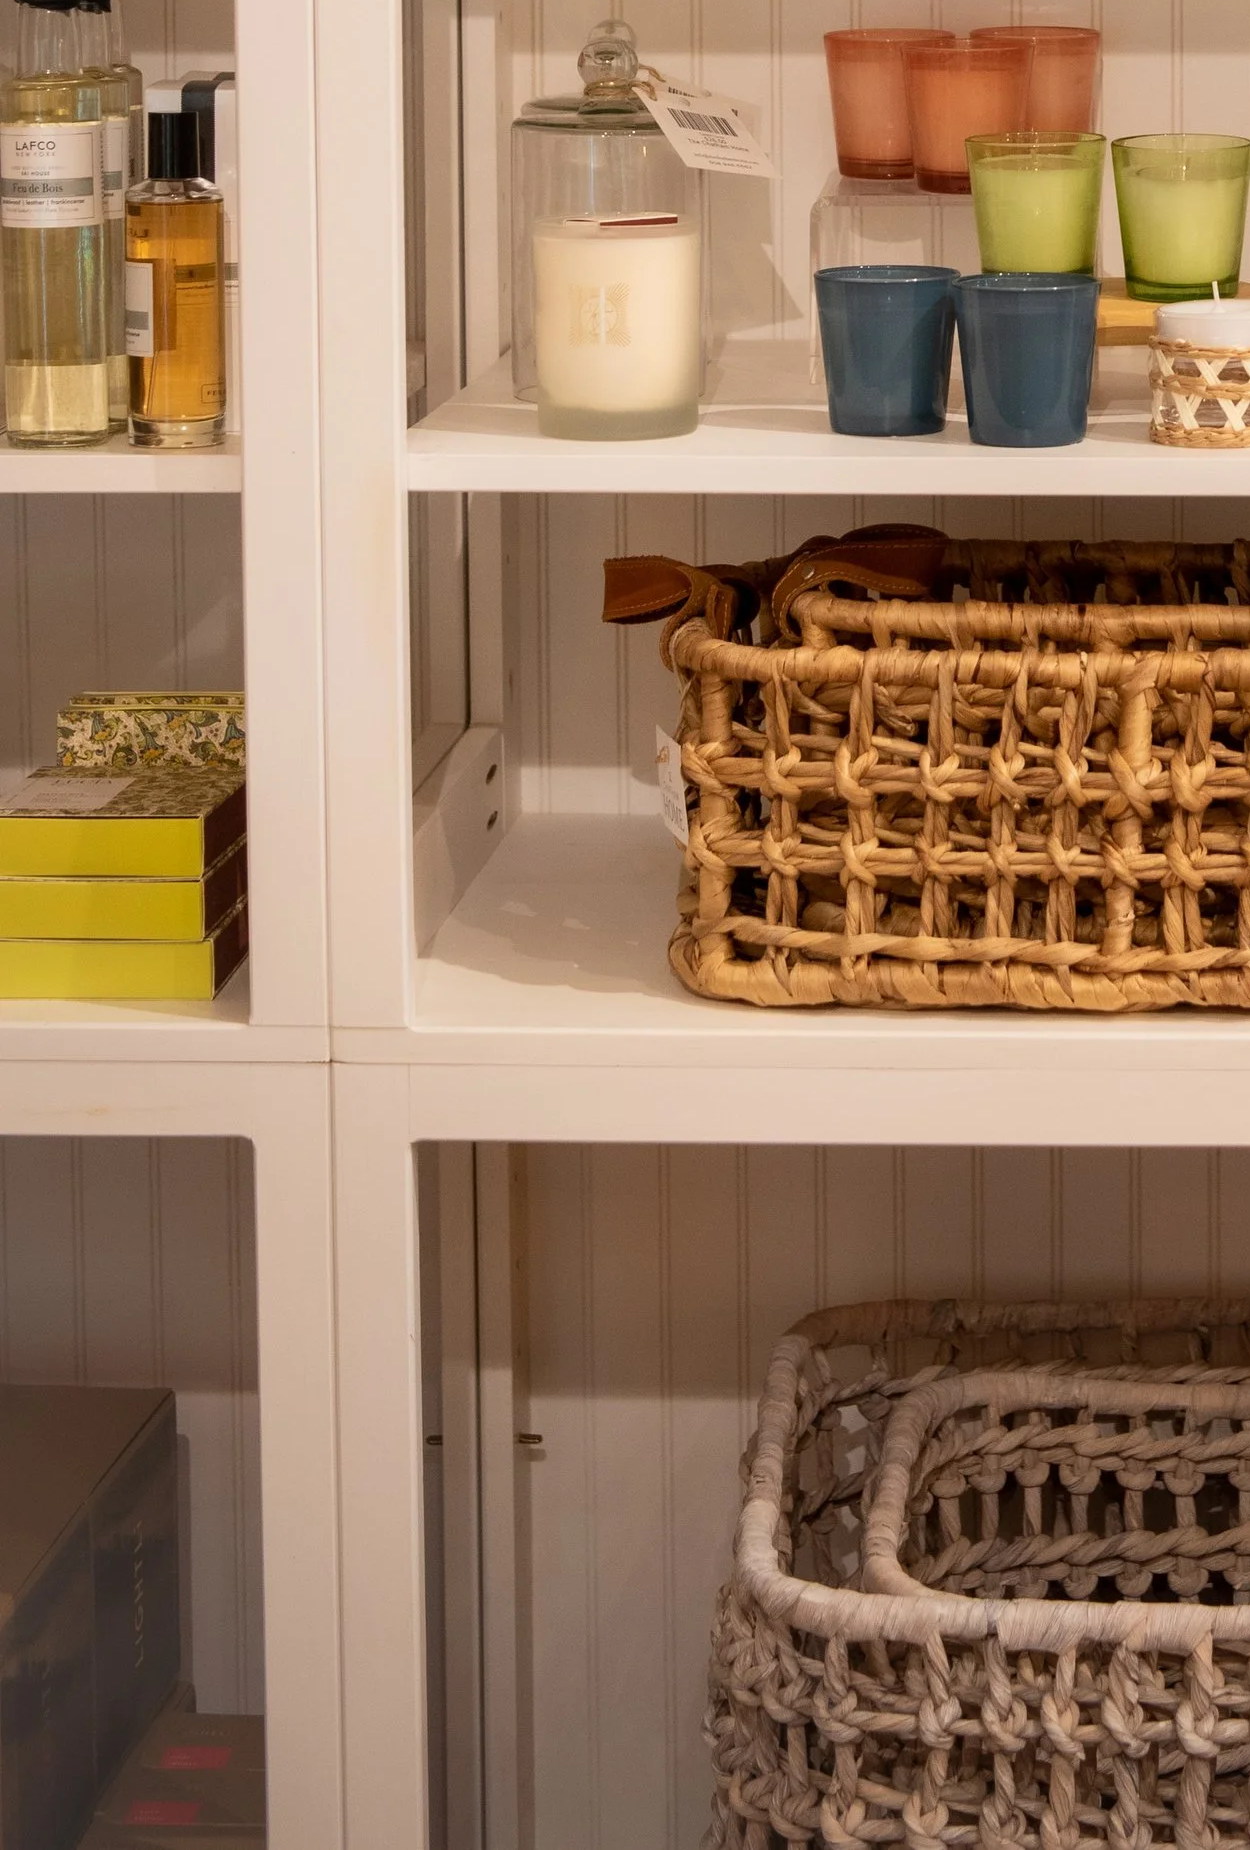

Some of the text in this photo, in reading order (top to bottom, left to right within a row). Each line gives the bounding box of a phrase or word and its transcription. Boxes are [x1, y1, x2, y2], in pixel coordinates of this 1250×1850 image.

[15, 141, 56, 151] LAFCO
[12, 183, 63, 193] Feu de Bois
